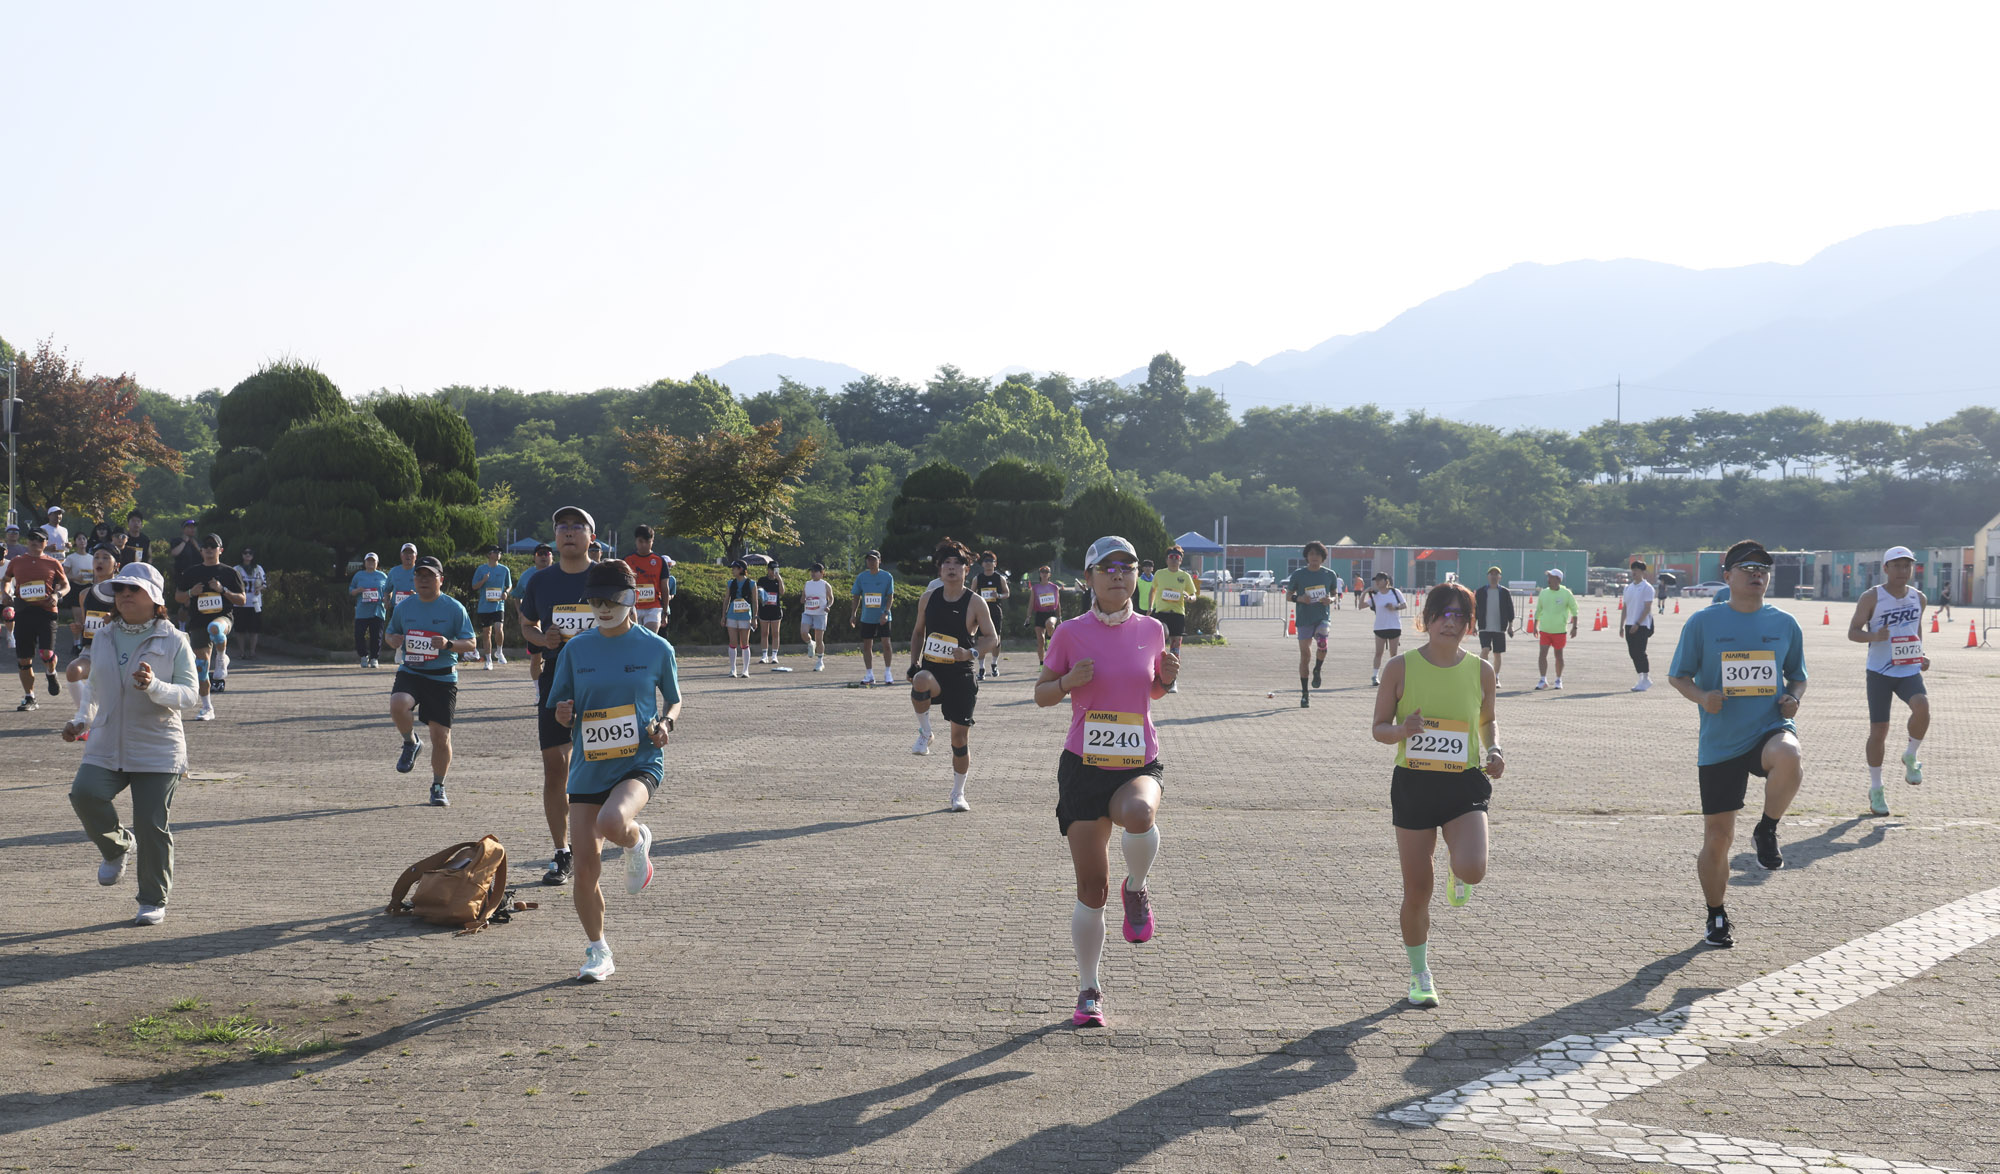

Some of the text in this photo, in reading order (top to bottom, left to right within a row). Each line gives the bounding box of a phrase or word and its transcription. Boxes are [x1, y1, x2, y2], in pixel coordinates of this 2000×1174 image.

[21, 586, 44, 596] 2306
[199, 599, 221, 607] 2310
[556, 617, 595, 630] 2317
[1880, 608, 1920, 626] TSRC
[928, 642, 954, 656] 1249
[1894, 644, 1921, 656] 5073
[1726, 665, 1773, 681] 3079
[1090, 712, 1118, 722] 시사저널
[585, 722, 635, 743] 2095
[1088, 729, 1140, 748] 2240
[1410, 735, 1463, 754] 2229
